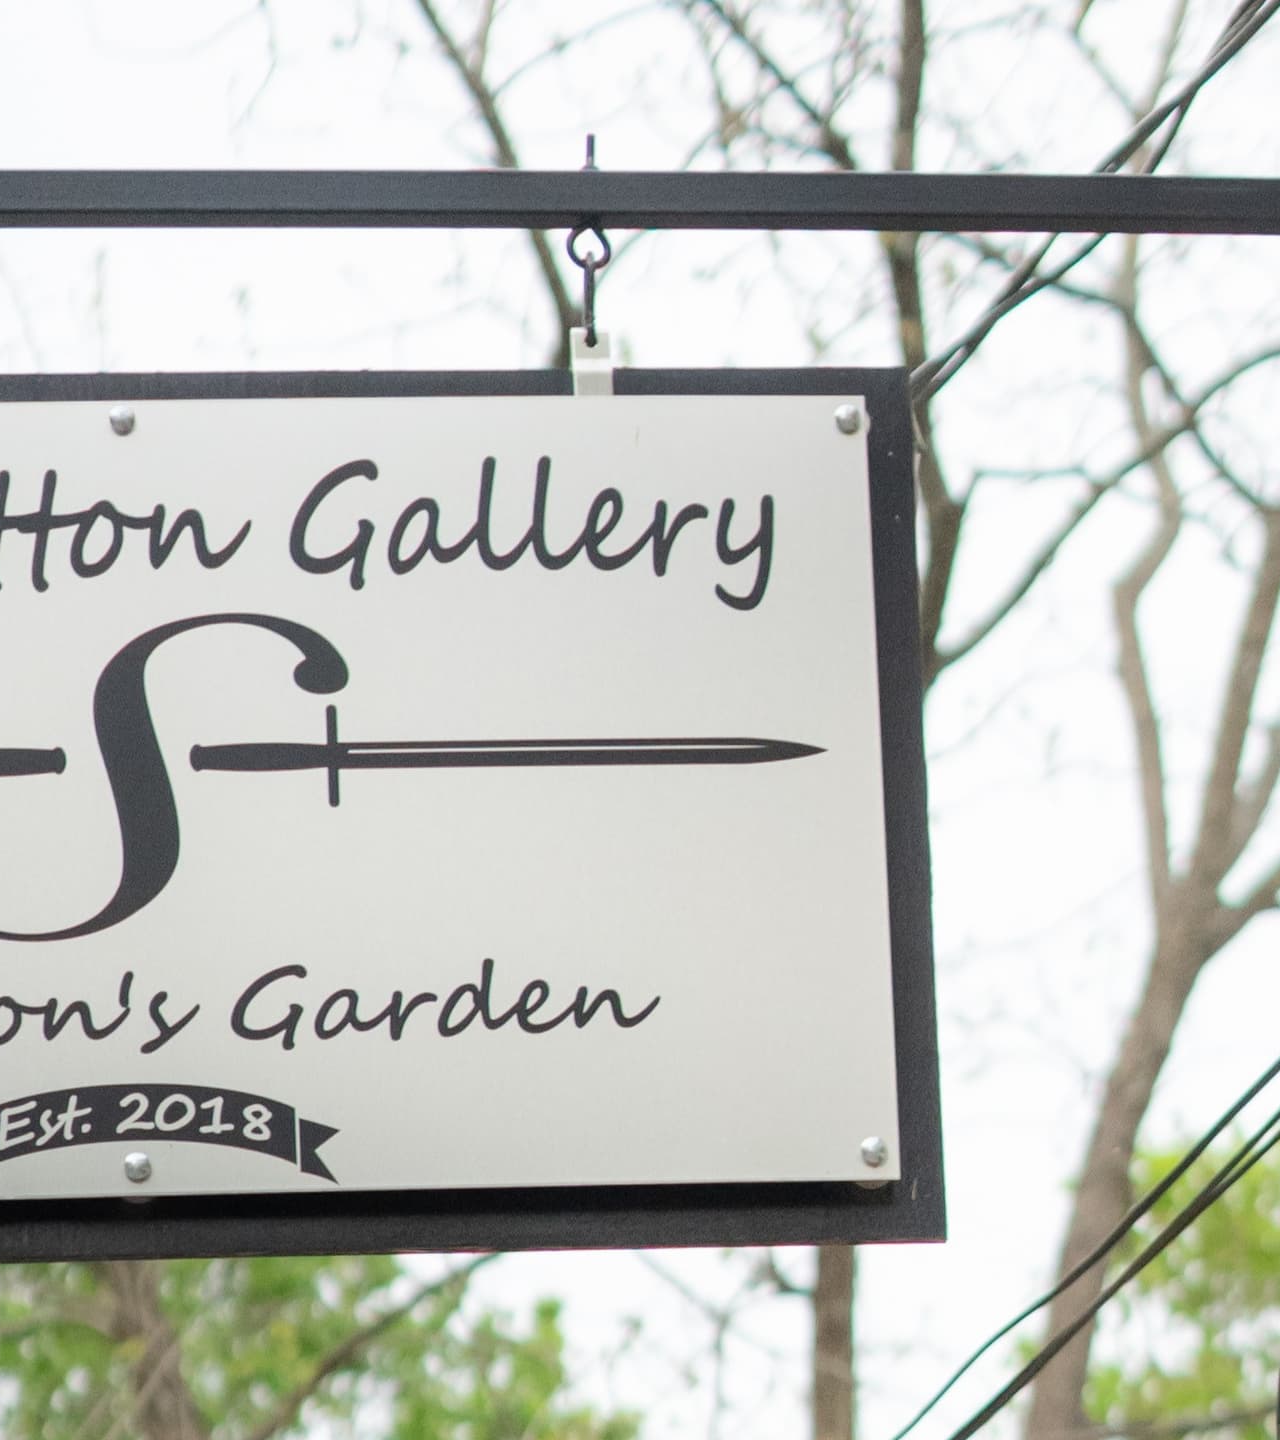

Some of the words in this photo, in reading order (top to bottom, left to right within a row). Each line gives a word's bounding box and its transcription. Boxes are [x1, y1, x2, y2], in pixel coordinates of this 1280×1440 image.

[289, 456, 775, 611] Gallery
[230, 958, 661, 1051] Garden
[116, 1092, 273, 1141] 2018
